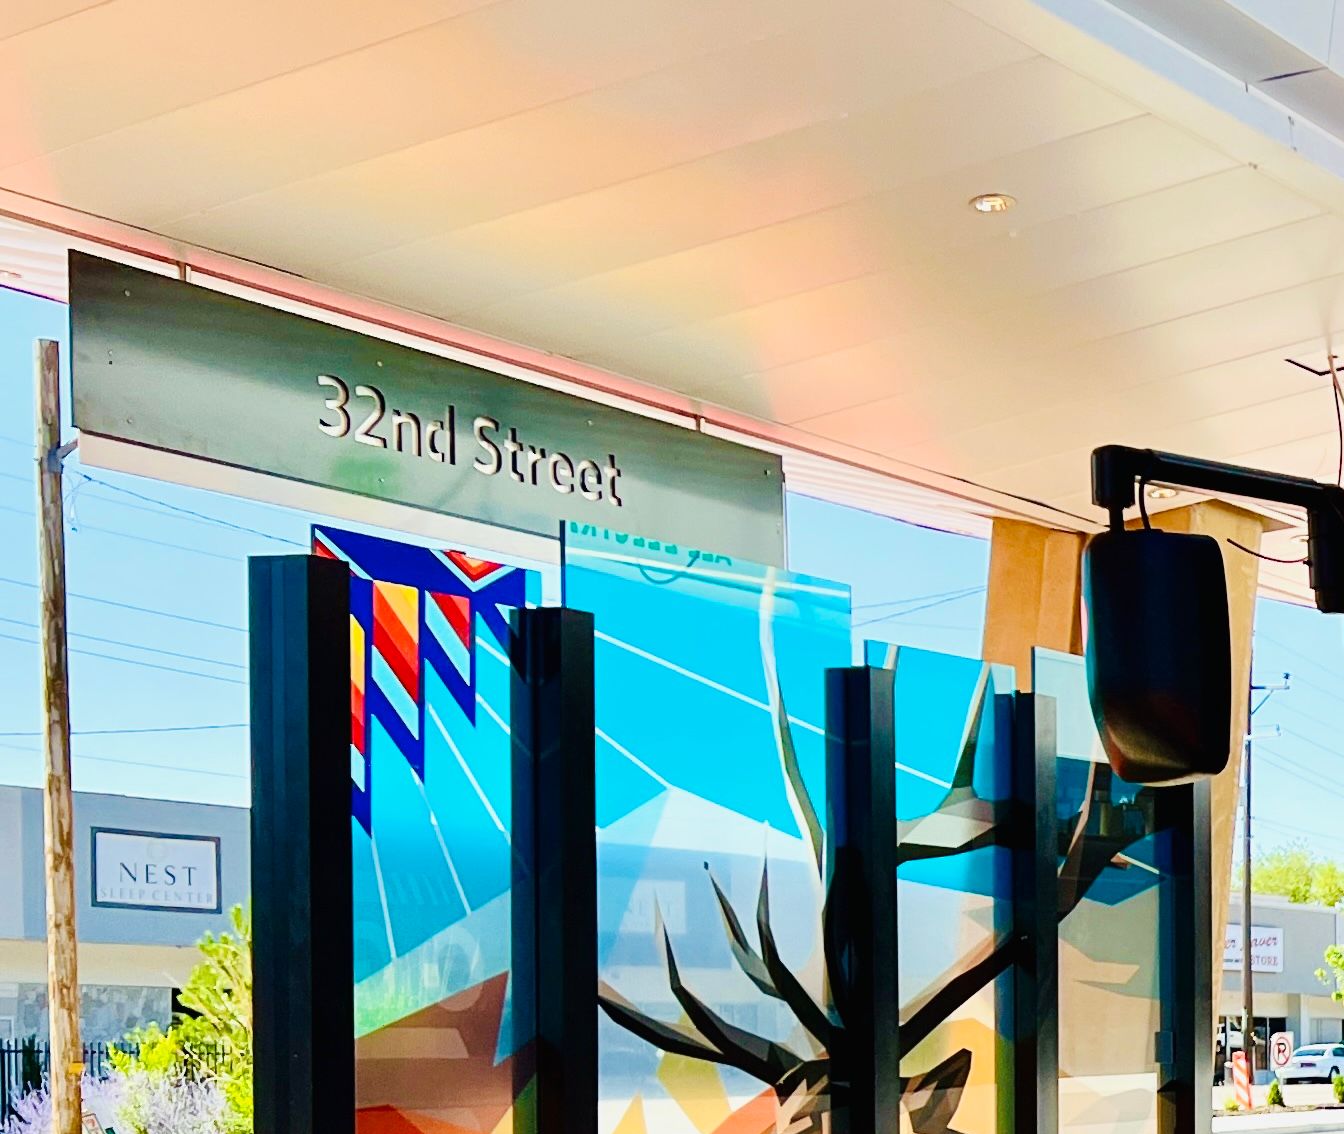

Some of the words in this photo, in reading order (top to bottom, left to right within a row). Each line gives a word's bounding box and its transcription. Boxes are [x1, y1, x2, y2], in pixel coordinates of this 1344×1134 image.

[317, 373, 456, 466] 32nd
[472, 415, 623, 507] Street
[119, 861, 198, 887] NEST
